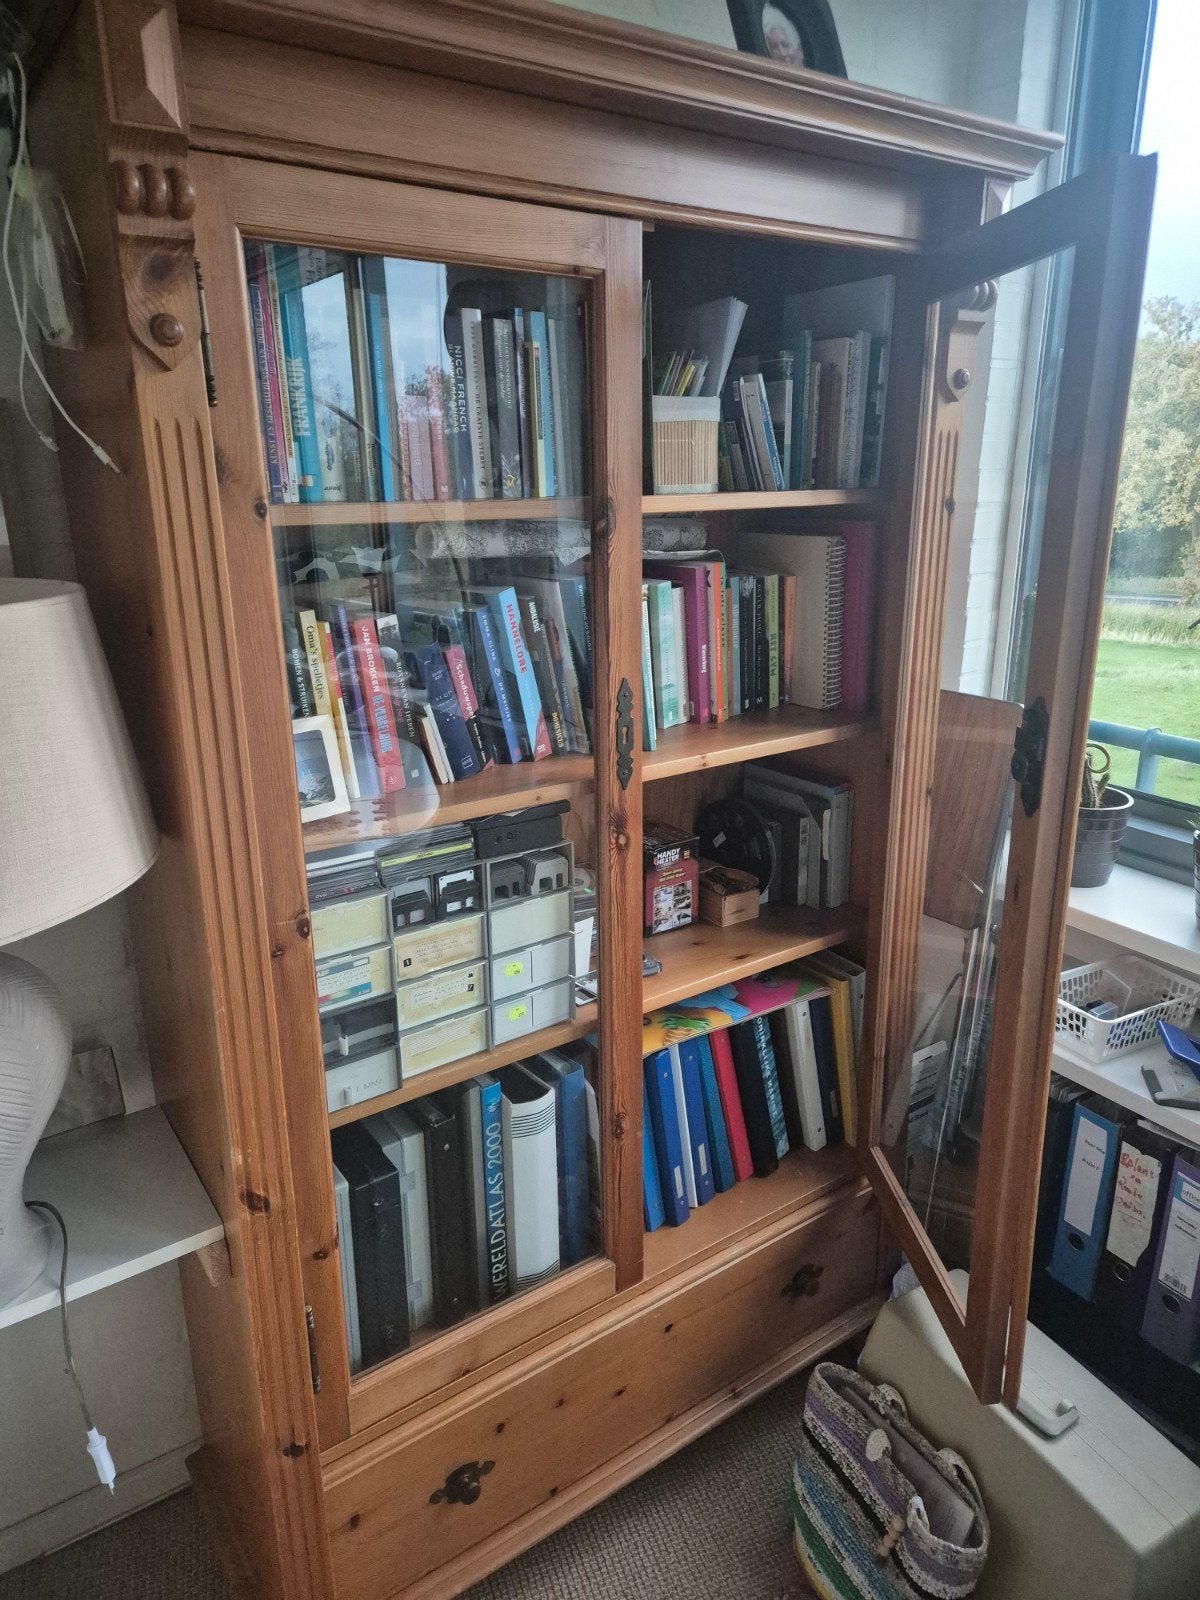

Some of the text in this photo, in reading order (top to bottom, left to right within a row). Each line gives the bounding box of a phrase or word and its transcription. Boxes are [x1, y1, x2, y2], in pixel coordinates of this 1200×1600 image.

[289, 356, 310, 436] FRANKRIJK
[447, 343, 459, 432] BLAUWE MAANDAG
[454, 345, 467, 432] NICCI FRENCH
[474, 393, 481, 404] DE
[475, 406, 483, 439] LAATSTE
[481, 614, 490, 637] EMMA
[505, 603, 528, 674] HANNELORE
[291, 648, 302, 675] BOMEN
[297, 683, 309, 717] STRUIKEN
[305, 625, 326, 700] Oma's spelletjes
[360, 625, 392, 753] JAN BROKKEN DE VERGELDING
[455, 662, 477, 720] Schaduwspel
[401, 693, 410, 708] VAN
[550, 711, 564, 747] DOMINICUS
[657, 848, 681, 860] HANDY
[657, 854, 680, 866] HEATER
[764, 1079, 778, 1116] MARINE
[485, 1122, 508, 1298] WERELDATLAS 2000
